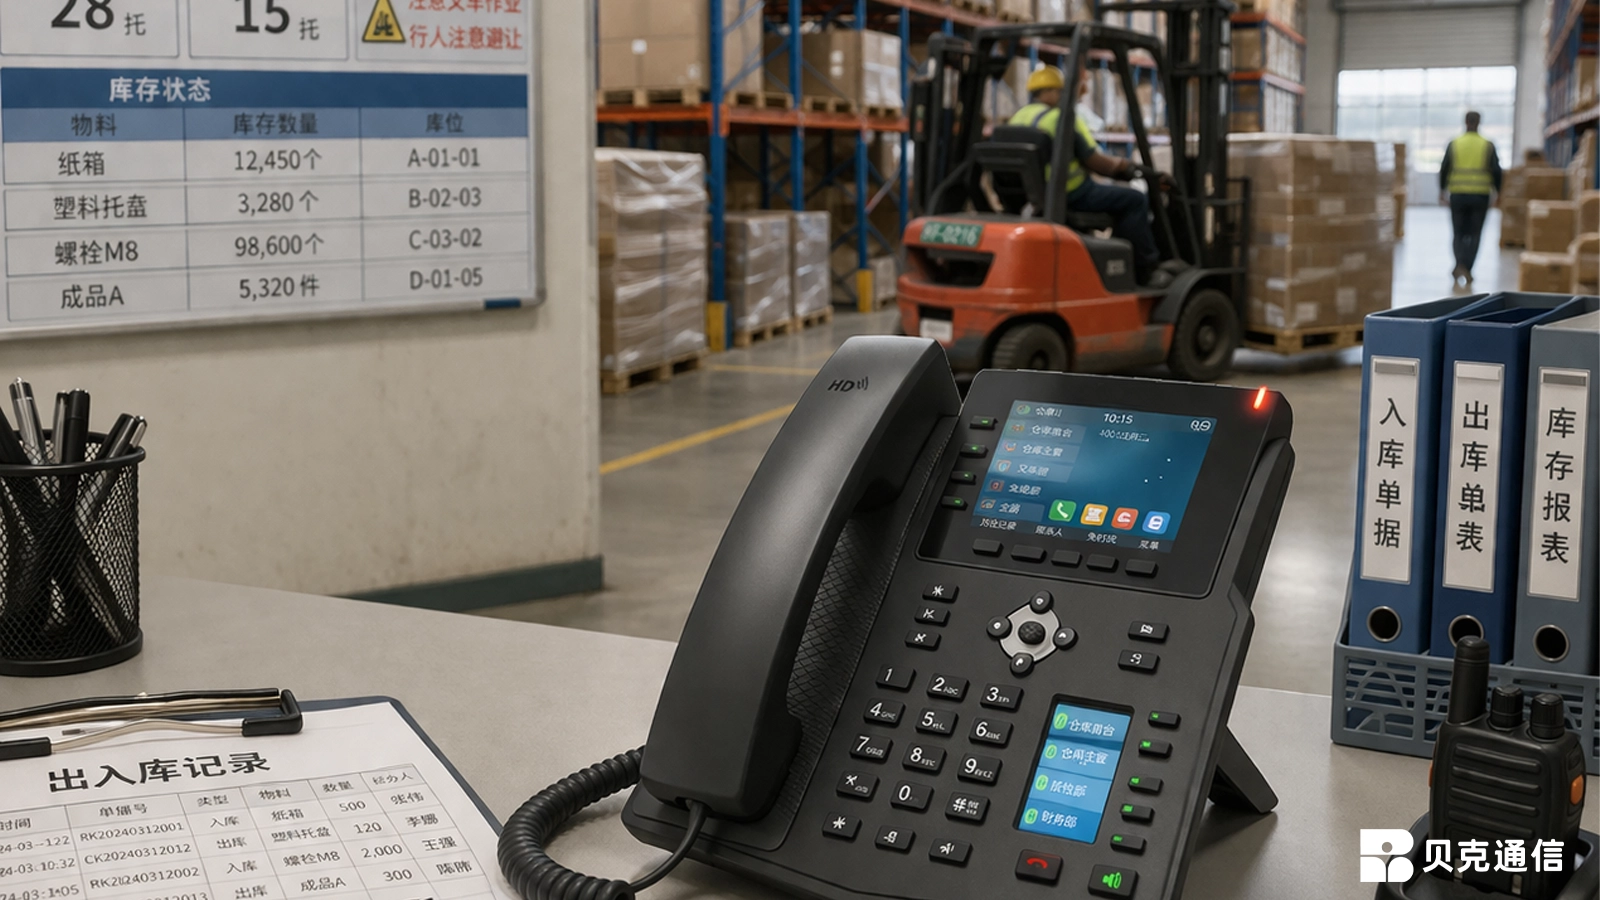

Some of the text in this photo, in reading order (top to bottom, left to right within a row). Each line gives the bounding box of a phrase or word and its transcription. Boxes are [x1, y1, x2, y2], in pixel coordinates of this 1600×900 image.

[51, 0, 147, 36] 28 托
[235, 0, 320, 41] 15 托
[108, 76, 212, 102] 库存状态
[70, 112, 118, 137] 物料
[233, 111, 319, 136] 库存数量
[425, 112, 464, 133] 库位
[57, 151, 105, 176] 纸箱
[407, 147, 481, 168] A-01-01
[408, 186, 482, 209] B-02-03
[408, 227, 483, 250] C-03-02
[54, 240, 139, 267] 螺栓M8
[409, 266, 484, 291] D-01-05
[60, 284, 125, 310] 成品A
[827, 379, 855, 392] HD
[1373, 397, 1407, 549] 入库单据
[1540, 406, 1577, 565] 库存报表
[48, 750, 272, 793] 出入库记录
[339, 800, 367, 812] 500
[79, 821, 185, 843] RK20240312001
[355, 821, 382, 834] 120
[83, 843, 192, 865] CK20240312012
[360, 843, 403, 859] 2,000
[382, 868, 413, 882] 300
